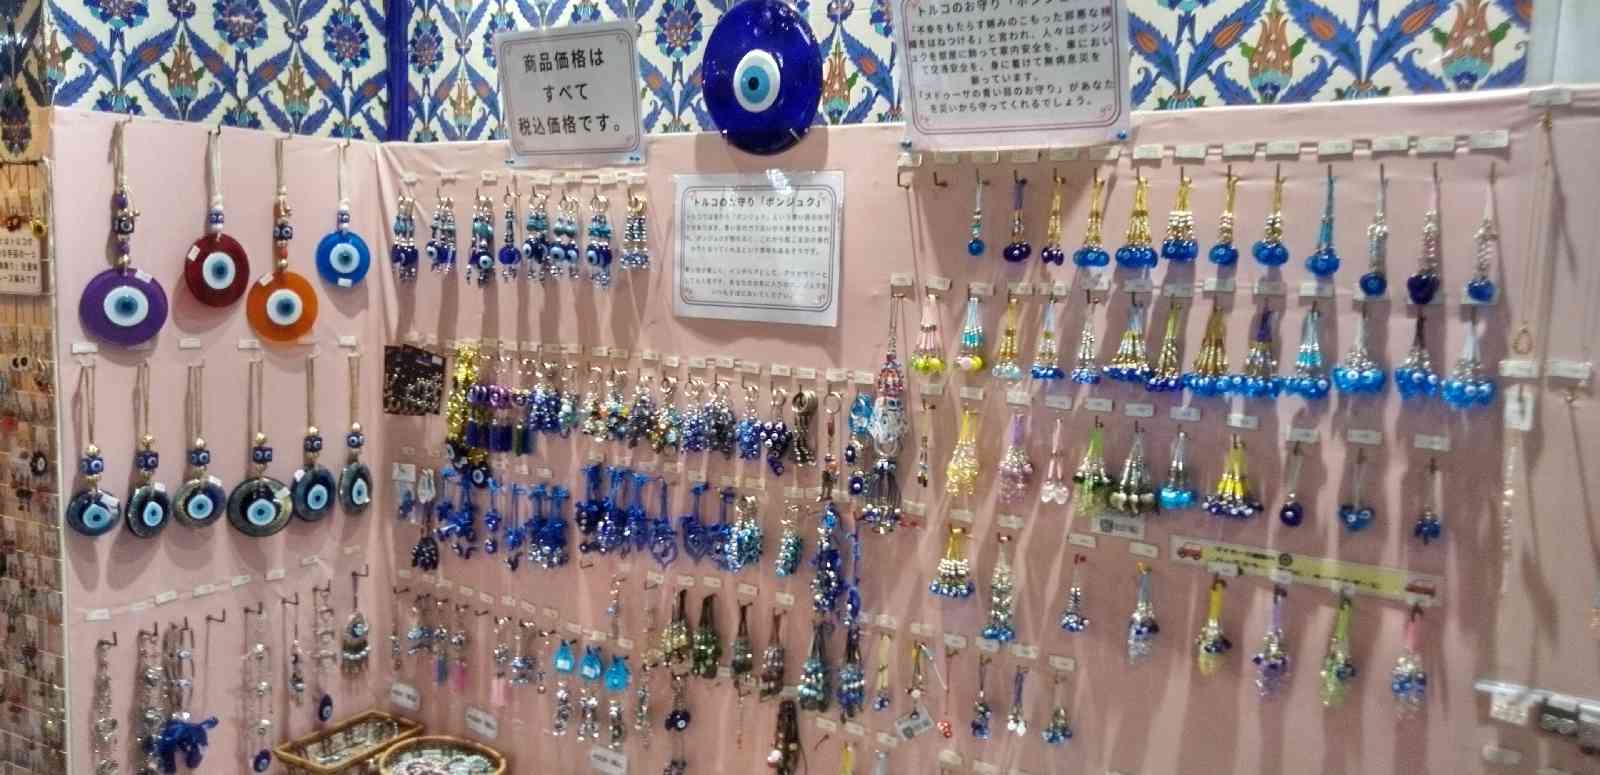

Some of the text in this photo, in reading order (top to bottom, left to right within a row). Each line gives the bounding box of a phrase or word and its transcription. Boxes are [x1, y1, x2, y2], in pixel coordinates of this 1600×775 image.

[523, 48, 604, 73] 商品価格は
[542, 83, 588, 103] すべて
[518, 113, 621, 136] 税込価格です。
